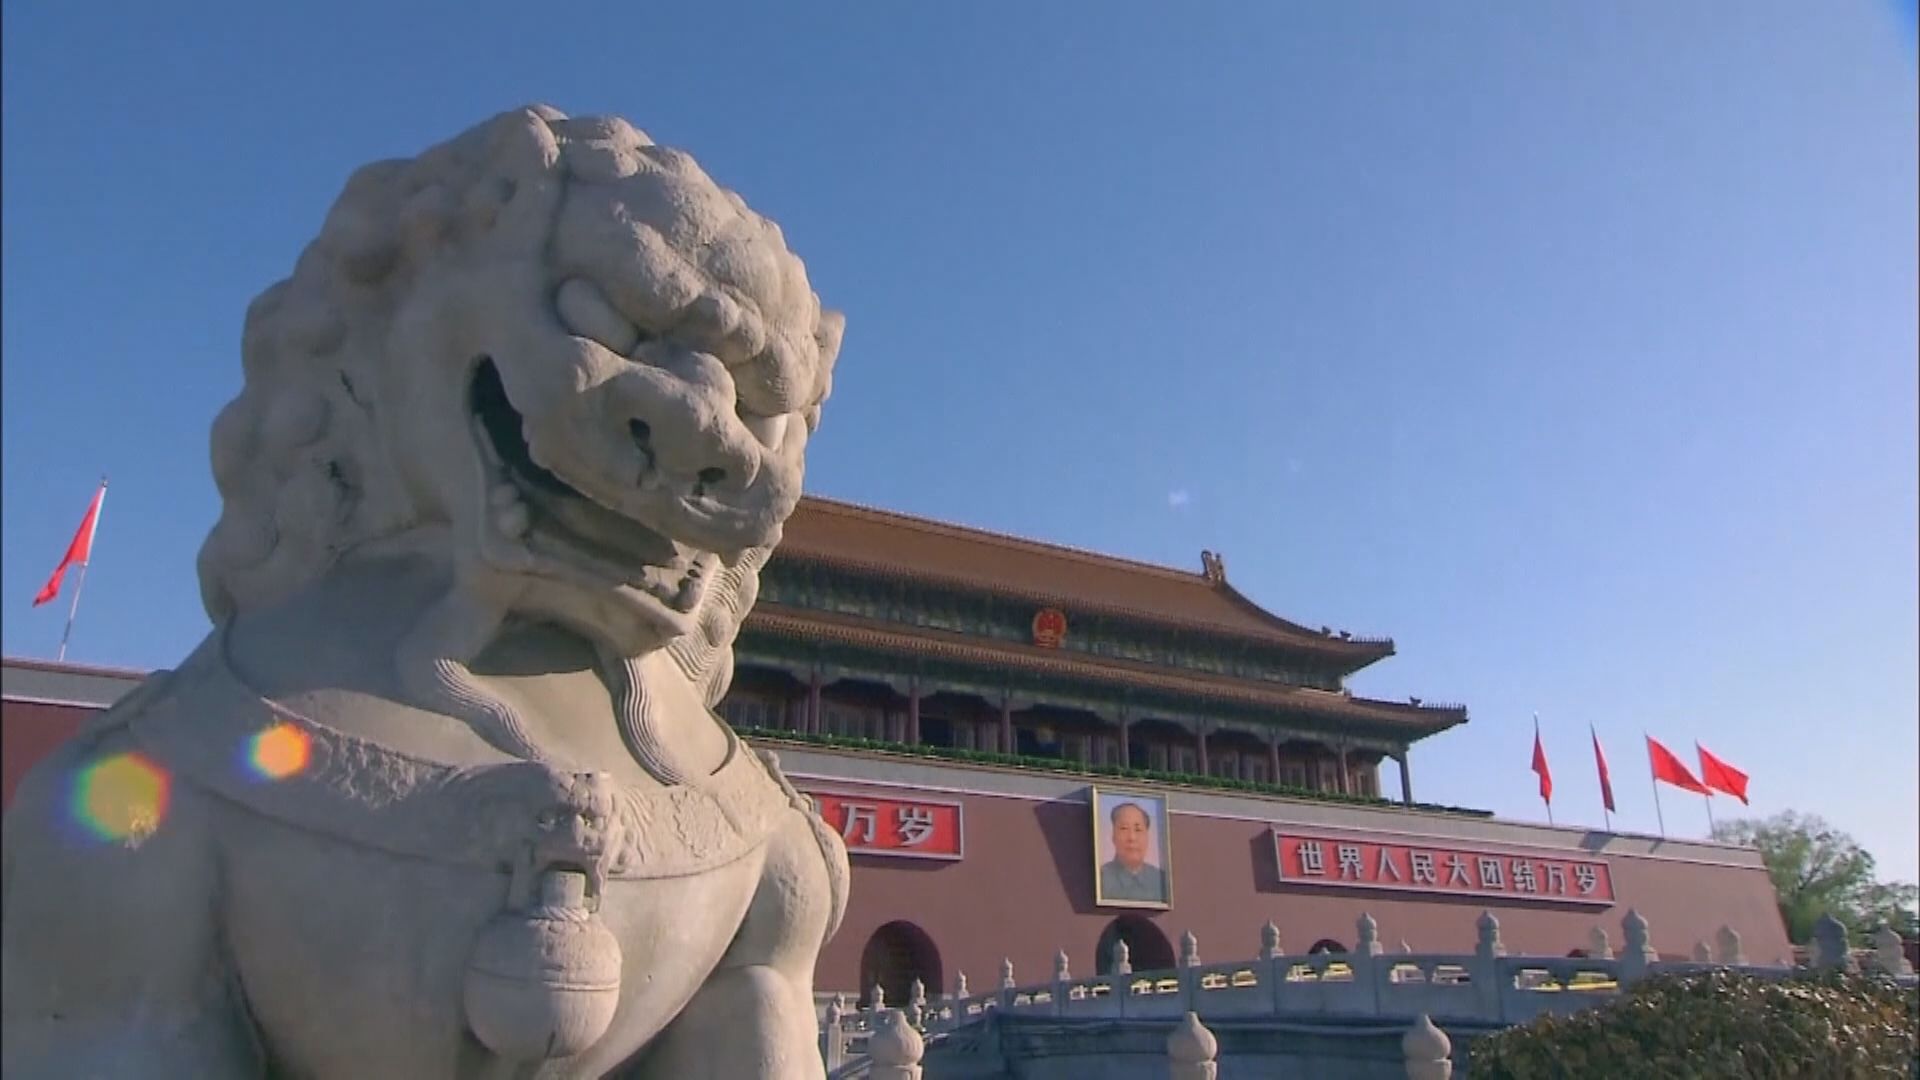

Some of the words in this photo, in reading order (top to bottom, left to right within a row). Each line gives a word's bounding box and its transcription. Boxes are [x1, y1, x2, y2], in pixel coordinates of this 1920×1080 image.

[814, 800, 935, 846] 万岁
[1298, 841, 1597, 895] 世界人民大团结万岁
